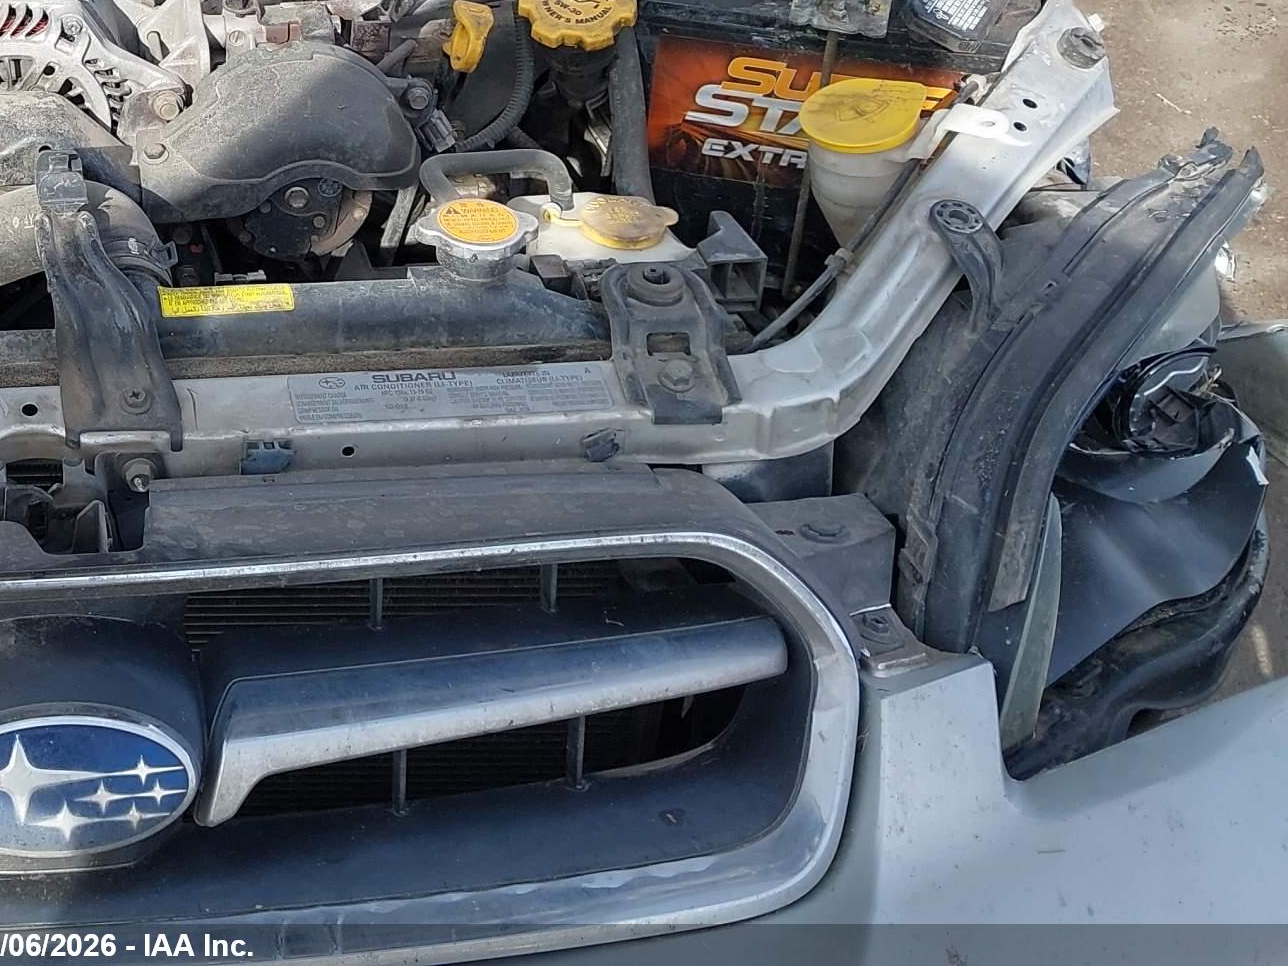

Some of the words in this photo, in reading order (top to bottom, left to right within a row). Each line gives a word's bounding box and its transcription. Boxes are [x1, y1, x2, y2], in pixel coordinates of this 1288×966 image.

[553, 0, 583, 16] 5W-30
[575, 6, 613, 25] MANUAL
[701, 137, 808, 169] EXTR
[354, 383, 370, 391] AIR
[371, 380, 432, 391] CONDITIONER
[371, 371, 457, 384] SUBARU
